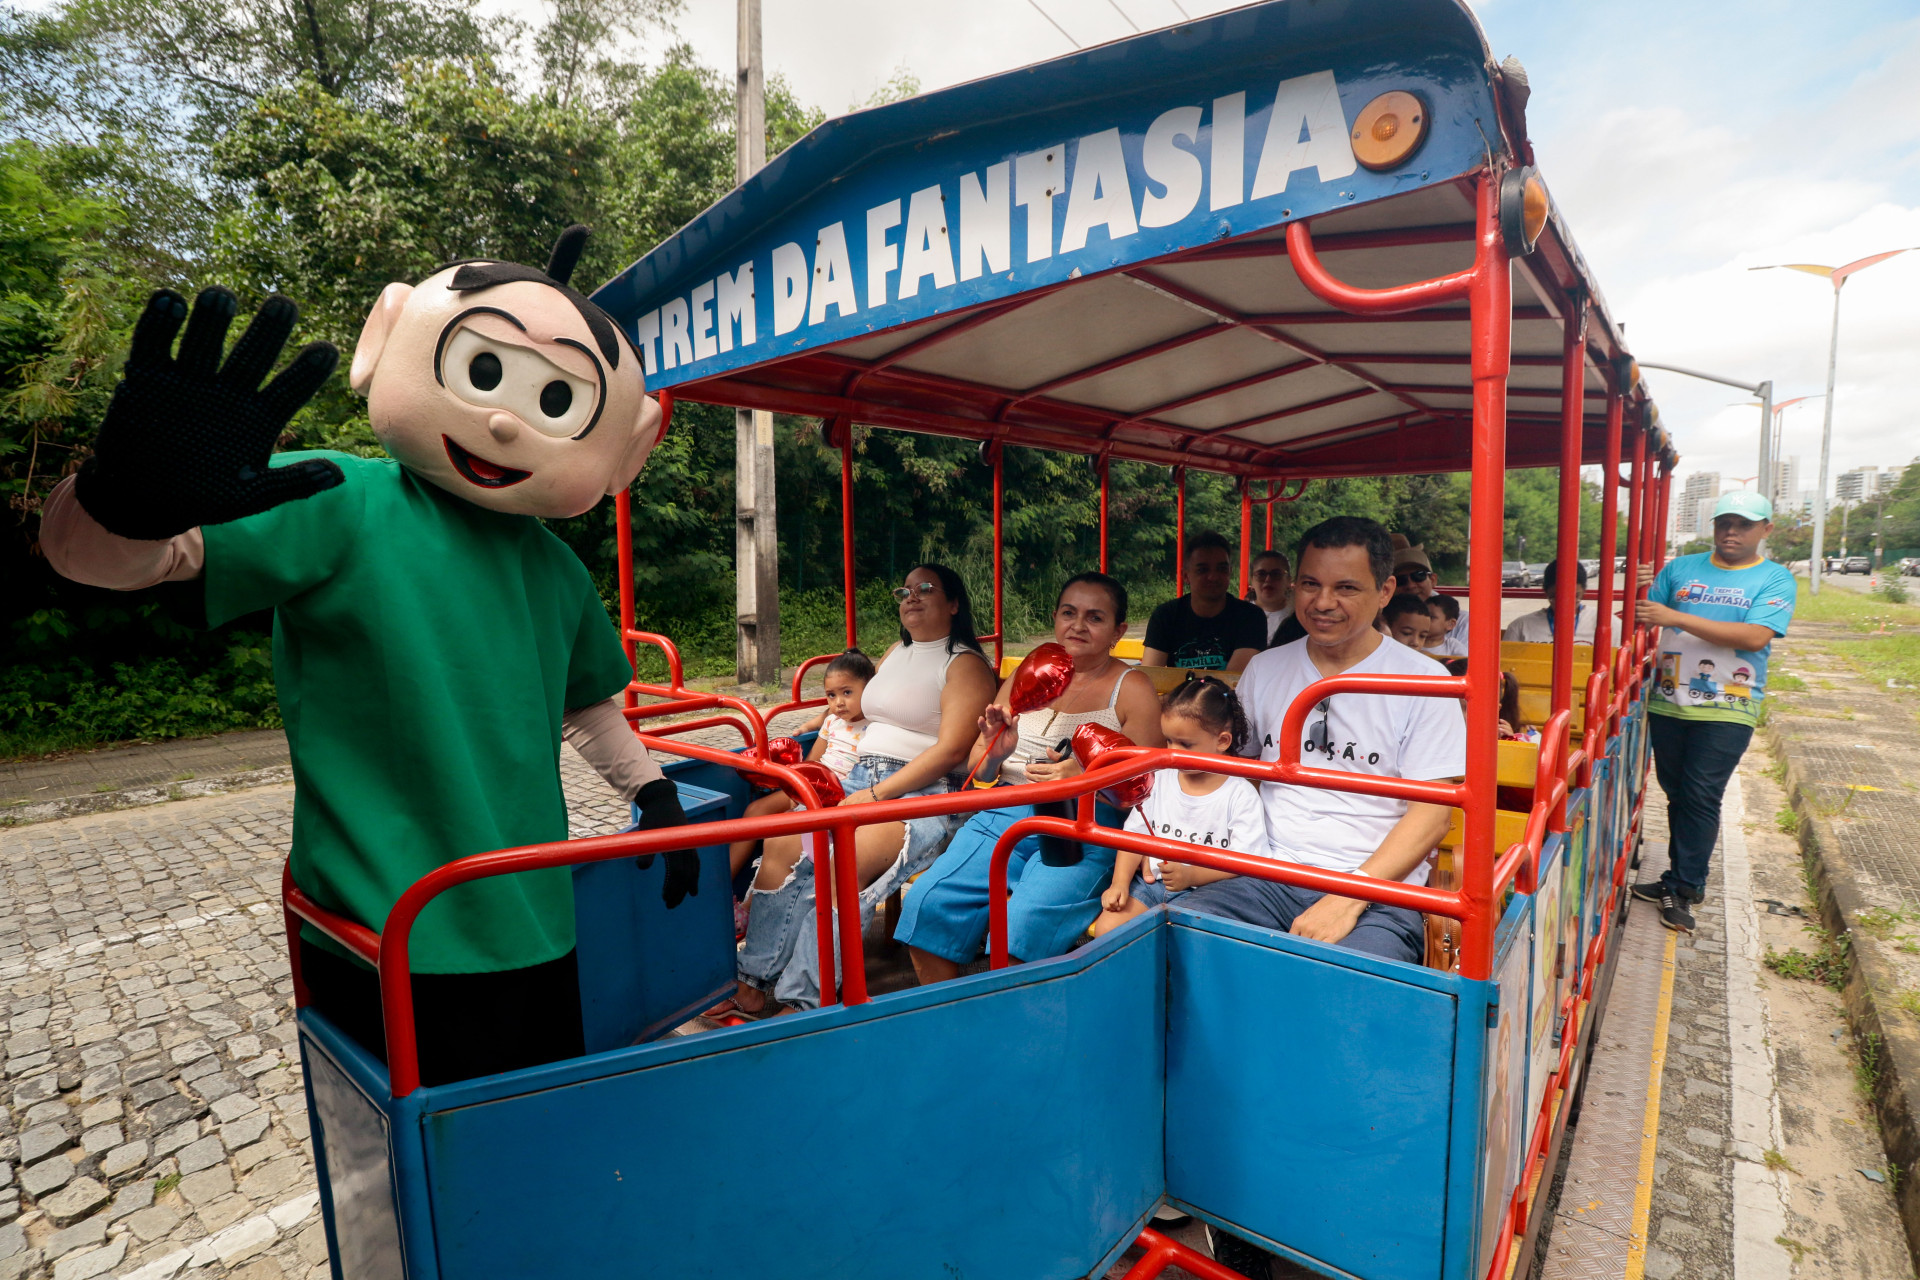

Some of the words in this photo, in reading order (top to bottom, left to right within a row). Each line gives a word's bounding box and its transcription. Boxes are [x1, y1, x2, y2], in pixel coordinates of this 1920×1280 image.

[637, 260, 757, 376] TREM
[772, 220, 858, 337] DA
[866, 69, 1358, 309] FANTASIA
[1702, 594, 1751, 609] FANTASIA
